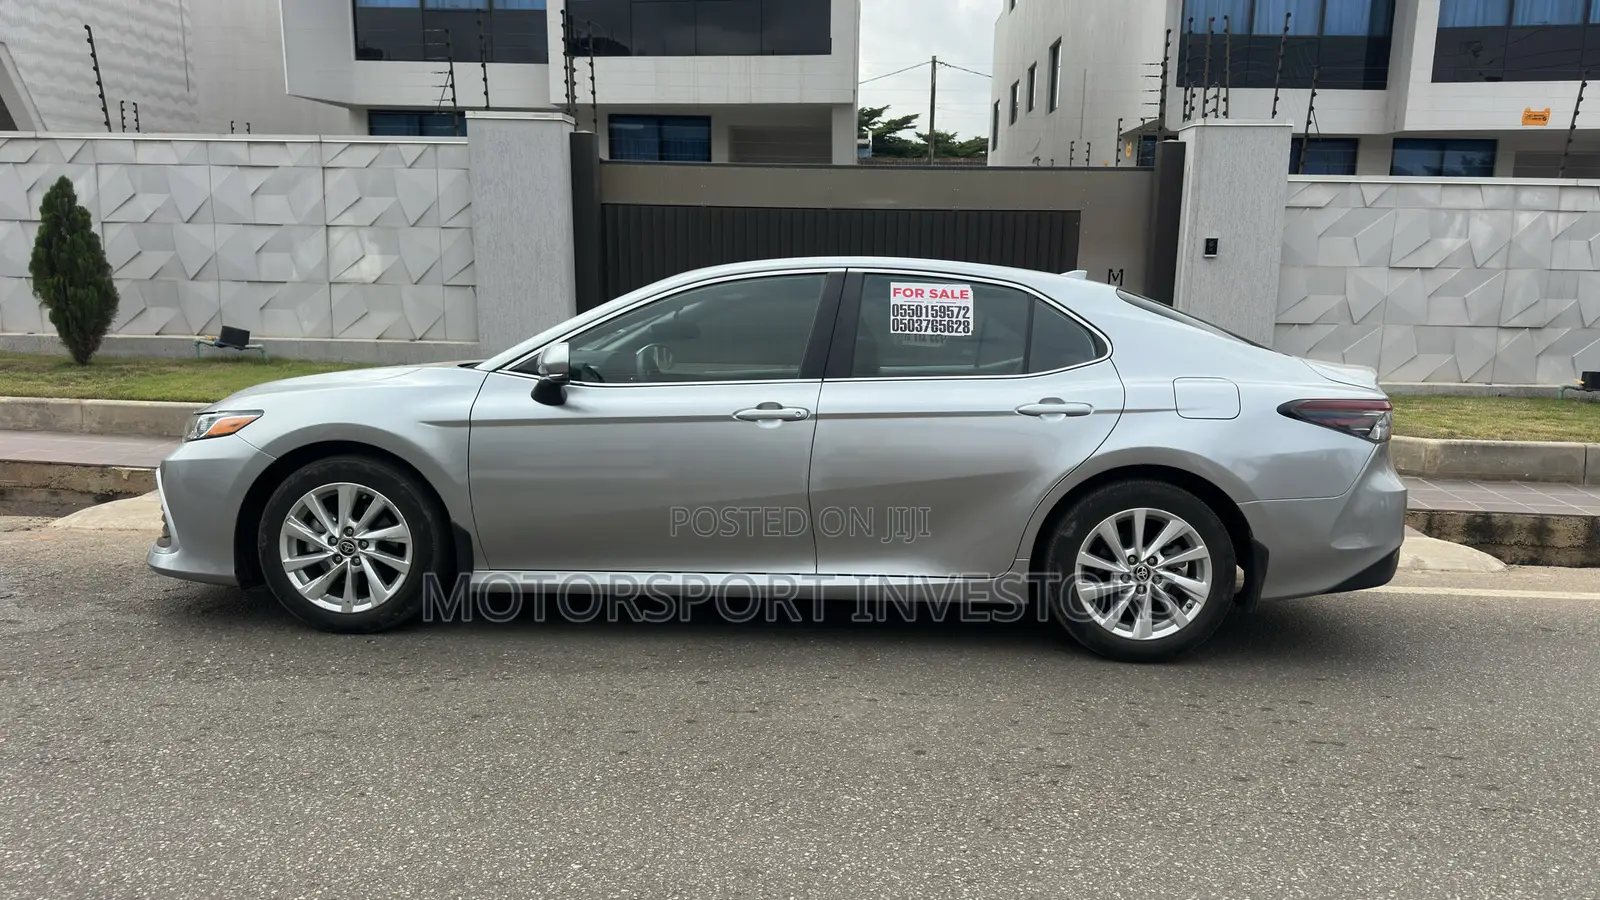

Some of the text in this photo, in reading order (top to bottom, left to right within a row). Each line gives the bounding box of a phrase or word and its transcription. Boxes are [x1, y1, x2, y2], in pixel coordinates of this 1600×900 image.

[893, 288, 969, 299] FOR SALE
[892, 304, 970, 319] 0550159572
[892, 318, 970, 333] 0503765628
